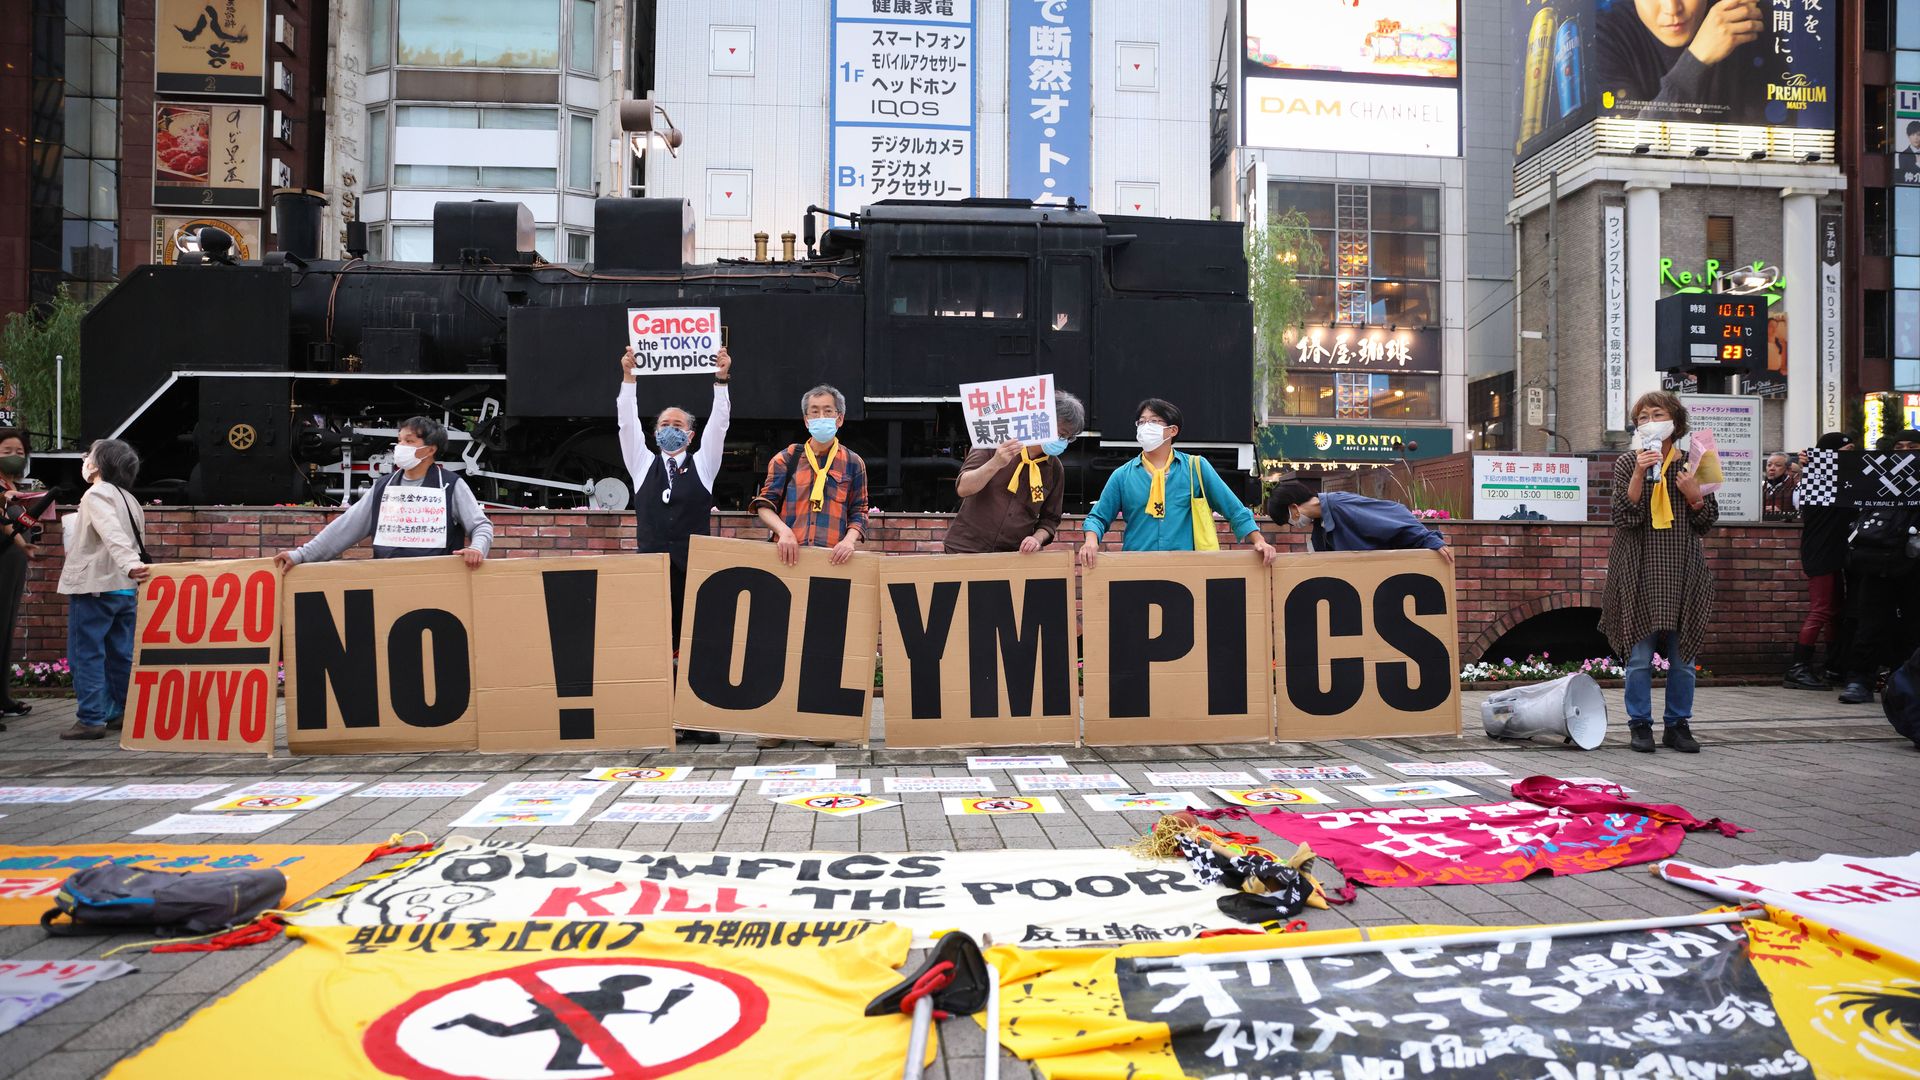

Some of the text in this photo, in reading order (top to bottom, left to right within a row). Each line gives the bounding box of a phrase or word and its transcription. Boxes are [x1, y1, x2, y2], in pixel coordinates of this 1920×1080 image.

[872, 0, 954, 16] 健康家電
[872, 30, 966, 49] スマートフォン
[840, 62, 865, 82] 1F
[872, 53, 967, 72] モバイルアクセサリー
[204, 77, 216, 91] 2
[872, 77, 957, 95] ヘッドホン
[1767, 83, 1827, 102] PREMIUM
[872, 100, 939, 117] IQOS
[1260, 96, 1444, 123] DAM CHANNEL
[872, 136, 964, 155] デジタルカメラ
[838, 166, 865, 187] B1
[872, 159, 932, 178] デジカメ
[872, 178, 962, 196] アクセサリー
[201, 189, 214, 205] 2
[1690, 304, 1706, 314] 時刻
[632, 312, 716, 335] Cancel
[1690, 325, 1706, 334] 気温
[1723, 325, 1741, 338] 24
[638, 335, 712, 351] the TOKYO
[1296, 335, 1413, 367] 椿屋珈琲
[1722, 345, 1743, 359] 23
[634, 351, 718, 372] Olympics
[968, 378, 1047, 417] 中止だ!
[972, 411, 1051, 445] 東京五輪
[1335, 433, 1402, 446] PRONTO
[1492, 461, 1570, 475] 汽笛一声時間
[1487, 489, 1574, 500] 12:00 15:00 18:00
[141, 569, 276, 644] 2020
[542, 569, 599, 740] !
[687, 565, 1451, 719] OLYMPICS
[132, 667, 268, 744] TOKYO
[441, 854, 946, 882] OLYMPICS
[531, 869, 1201, 917] KILL THE POOR
